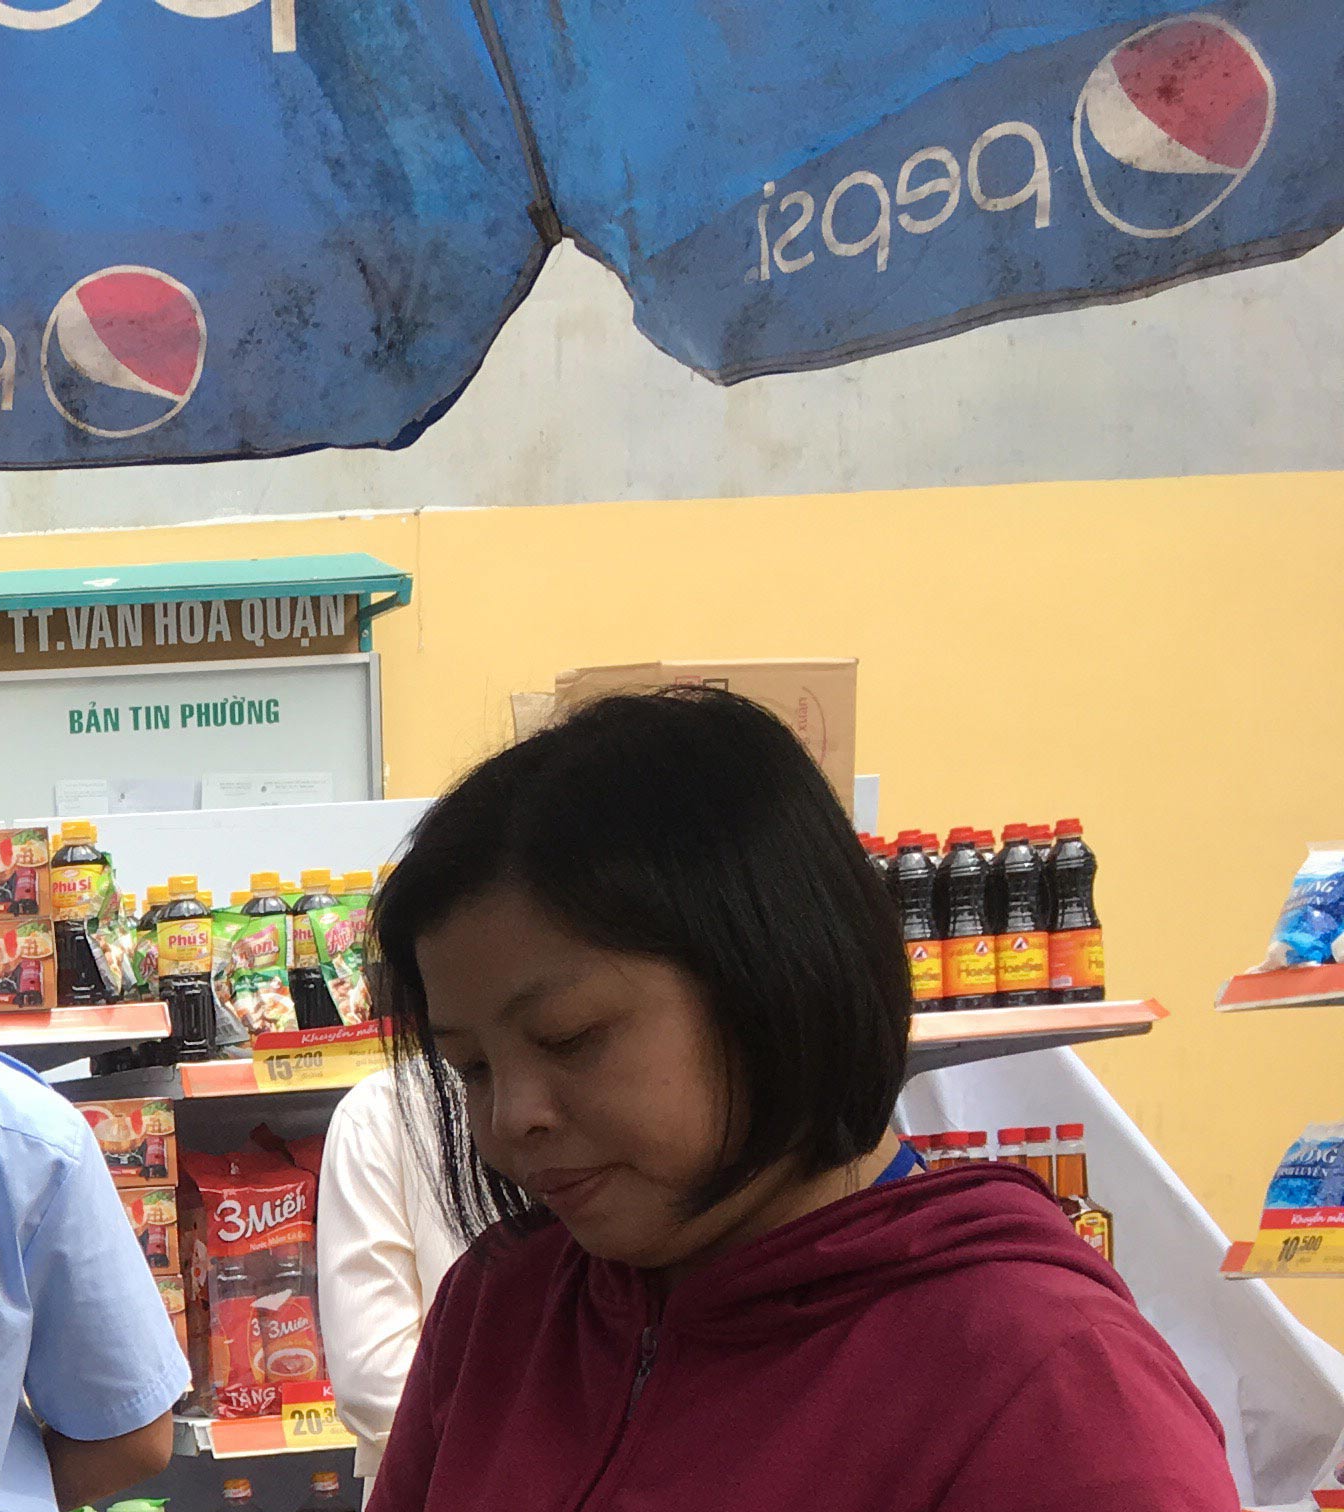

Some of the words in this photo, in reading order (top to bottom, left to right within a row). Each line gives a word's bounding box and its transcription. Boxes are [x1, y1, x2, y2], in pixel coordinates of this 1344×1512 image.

[68, 700, 121, 735] BẢN
[129, 704, 171, 732] TIN
[180, 694, 281, 729] PHƯỜNG
[290, 1407, 337, 1436] 20.3
